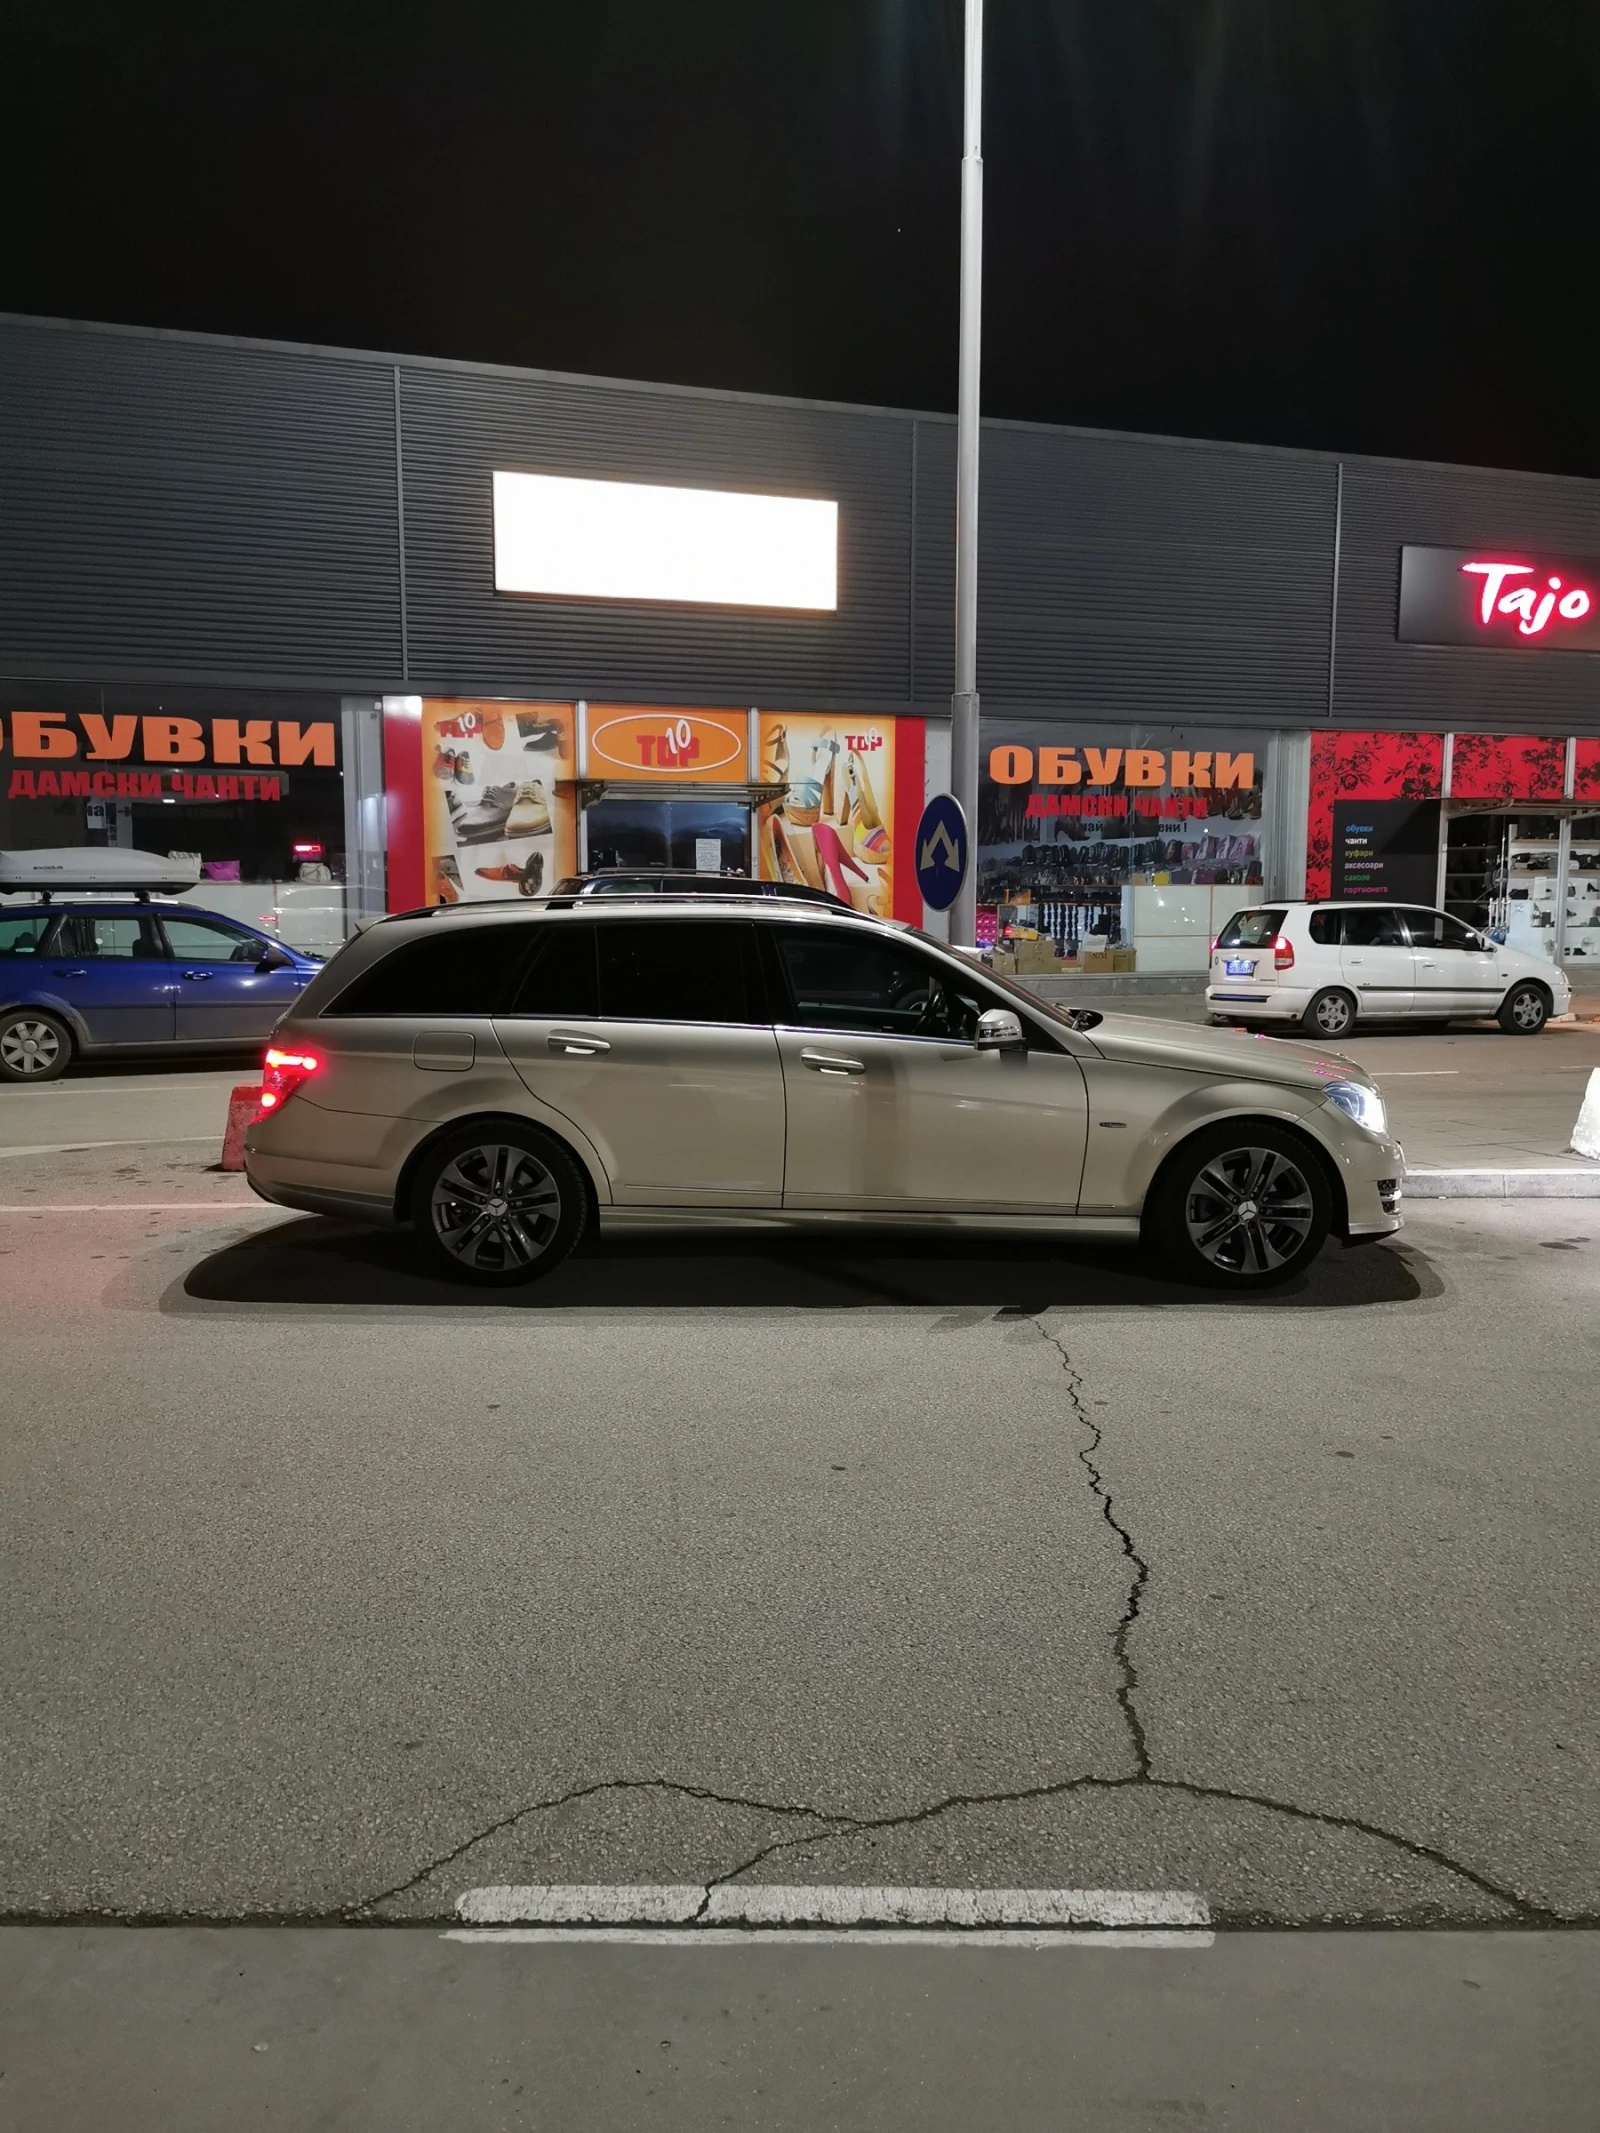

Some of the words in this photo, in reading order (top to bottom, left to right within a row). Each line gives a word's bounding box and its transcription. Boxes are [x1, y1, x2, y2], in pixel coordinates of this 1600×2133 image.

[1461, 562, 1590, 635] Tajo
[458, 712, 476, 732] 10
[665, 719, 691, 754] 10
[0, 711, 336, 766] БУВКИ
[636, 735, 700, 767] TOP
[989, 745, 1254, 789] ОБУВКИ
[8, 770, 162, 799] ДАМСКИ
[171, 774, 280, 801] ЧАНТИ
[1025, 794, 1128, 820] ДАМСКИ
[1134, 797, 1208, 819] ЧАНТИ
[1345, 823, 1374, 834] обувки
